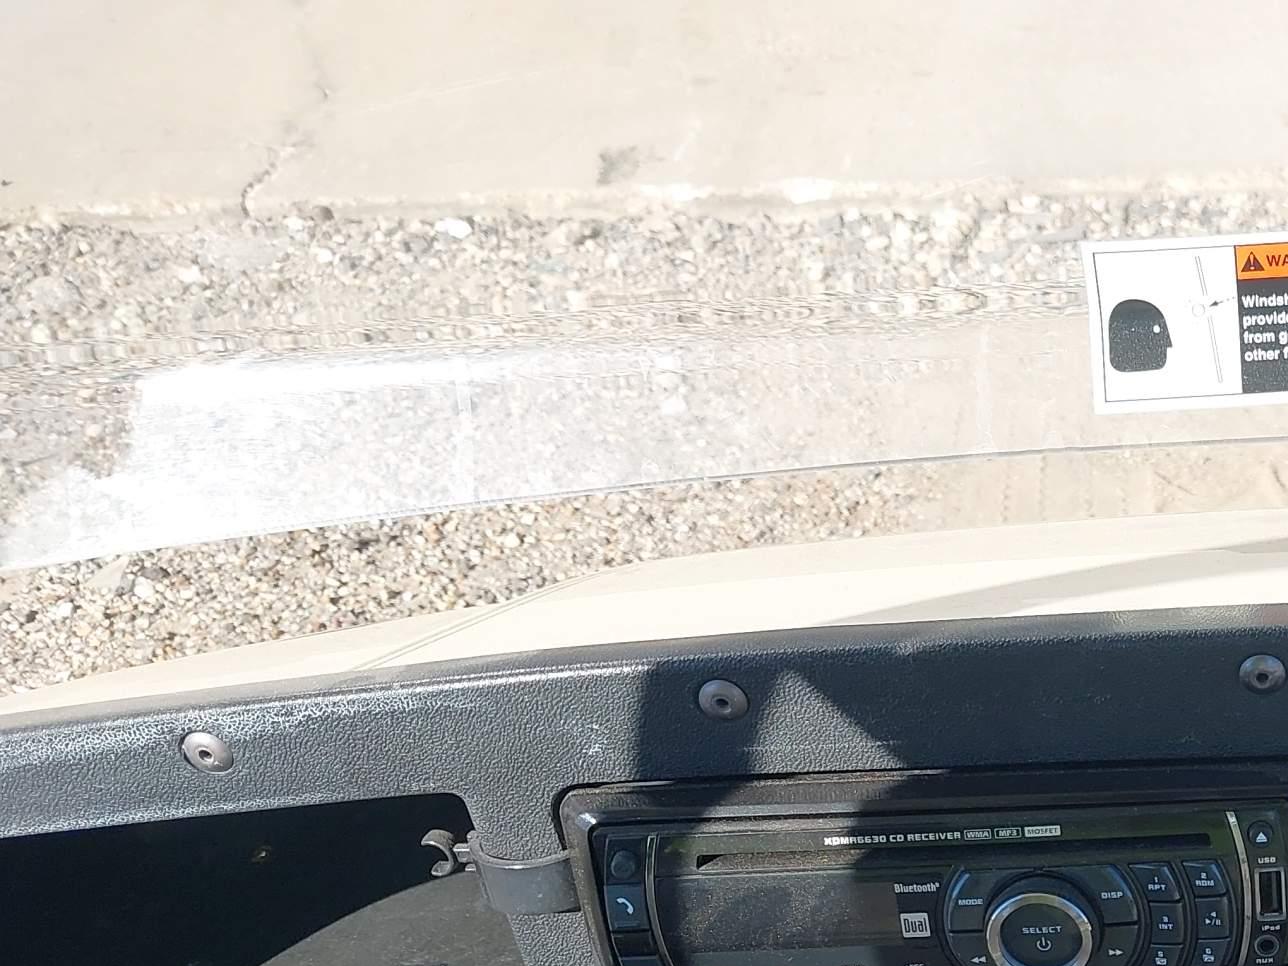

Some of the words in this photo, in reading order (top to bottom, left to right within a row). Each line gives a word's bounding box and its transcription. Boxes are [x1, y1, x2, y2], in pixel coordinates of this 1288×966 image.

[1243, 330, 1275, 344] from
[1245, 348, 1279, 362] other
[966, 830, 990, 838] WMA
[1026, 826, 1059, 836] MOSFET
[890, 834, 904, 842] CD
[907, 832, 961, 841] RECEIVER
[1101, 891, 1123, 899] DISP
[903, 918, 928, 933] Dual
[1022, 925, 1062, 934] SELECT
